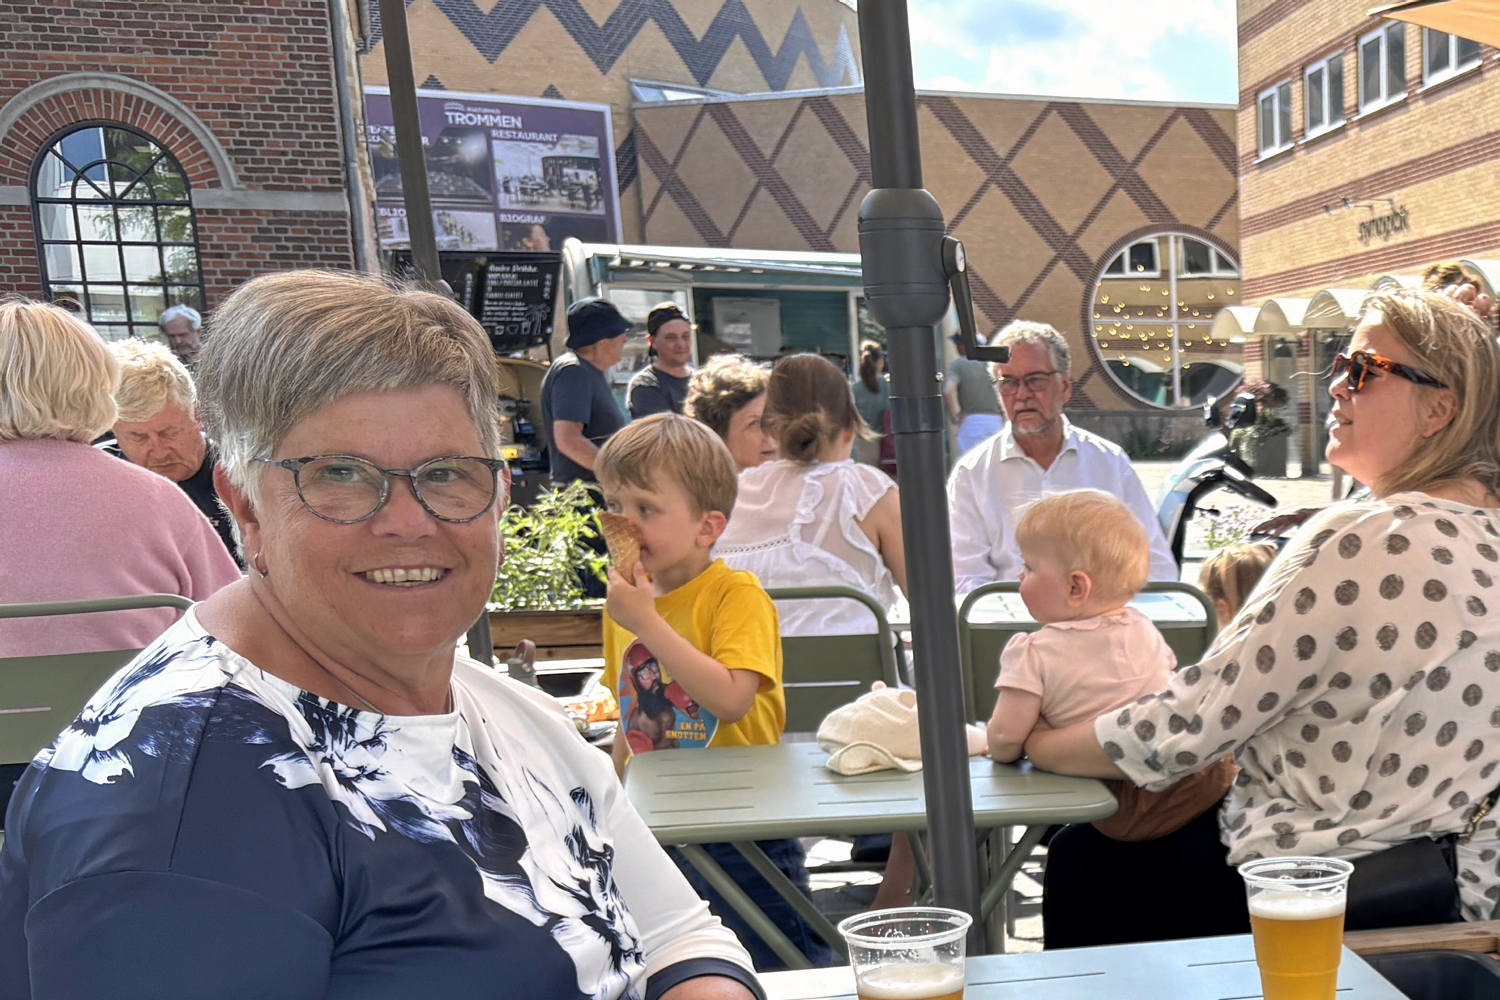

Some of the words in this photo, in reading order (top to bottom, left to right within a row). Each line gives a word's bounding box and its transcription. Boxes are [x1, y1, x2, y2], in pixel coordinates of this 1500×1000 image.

[444, 111, 523, 129] TROMMEN
[491, 129, 559, 142] RESTAURANT
[500, 213, 547, 224] BIOGRAF
[680, 722, 692, 730] EN
[694, 719, 706, 731] PÅ
